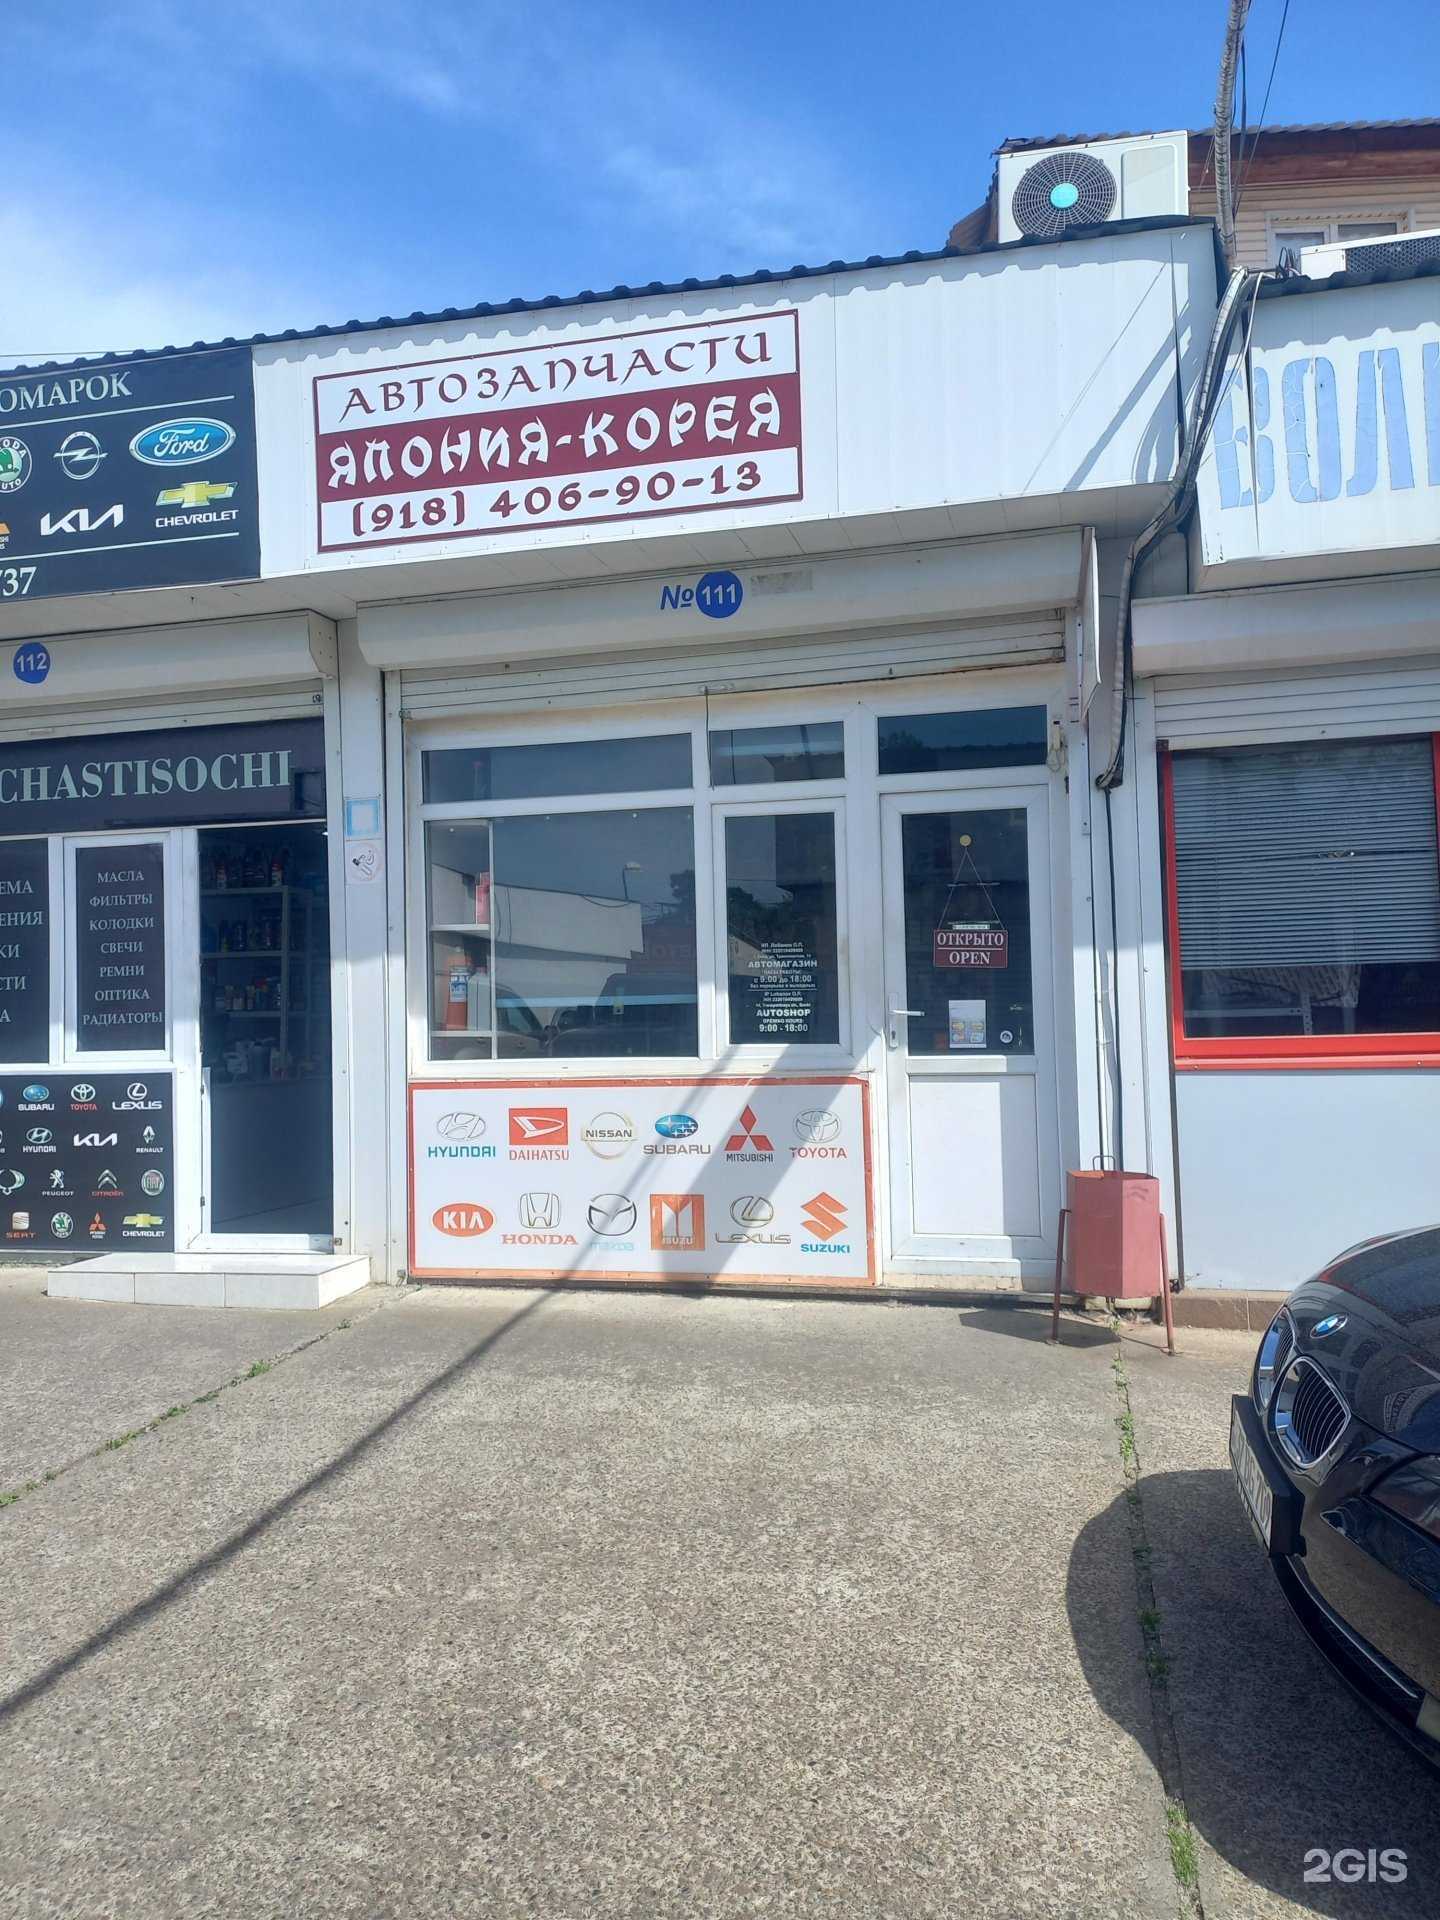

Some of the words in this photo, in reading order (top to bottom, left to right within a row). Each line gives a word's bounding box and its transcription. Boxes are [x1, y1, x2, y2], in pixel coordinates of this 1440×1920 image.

[340, 331, 772, 422] АВТОЗАПЧАСТИ
[153, 428, 209, 457] Ford
[328, 386, 782, 488] ЯПОНИЯ-КОРЕЯ
[489, 461, 761, 519] 406-90-13
[41, 504, 124, 536] KIA
[155, 509, 239, 528] CHEVROLET
[0, 566, 37, 596] 37
[17, 652, 47, 672] 112
[0, 750, 292, 803] CHASTISOCHI
[97, 870, 144, 883] МАСЛА
[89, 894, 153, 907] ФИЛЬТРЫ
[89, 917, 154, 931] КОЛОДКИ
[937, 932, 1004, 946] ОТКРЫТО
[100, 941, 143, 954] СВЕЧИ
[748, 960, 818, 968] АВТОМАГАЗИН
[950, 951, 990, 964] OPEN
[100, 965, 144, 977] РЕМНИ
[94, 988, 150, 1001] ОПТИКА
[83, 1012, 162, 1026] РАДИАТОРЫ
[756, 1009, 811, 1017] AUTOSHOP
[759, 1024, 778, 1032] 9:00
[785, 1024, 808, 1032] 18:00
[18, 1103, 55, 1111] SUBARU
[70, 1103, 97, 1111] TOYOTA
[112, 1101, 162, 1110] LEXUS
[73, 1133, 118, 1147] KIA
[585, 1129, 632, 1138] NISSAN
[23, 1145, 56, 1153] HYUNDAI
[428, 1146, 496, 1158] HYUNDAI
[509, 1150, 569, 1161] DAIHATSU
[643, 1144, 711, 1155] SUBARU
[789, 1147, 847, 1159] TOYOTA
[726, 1153, 774, 1163] MITSUBISHI
[443, 1211, 485, 1229] KIA
[122, 1230, 165, 1238] CHEVROLET
[502, 1234, 578, 1245] HONDA
[715, 1233, 792, 1245] LEXUS
[800, 1243, 850, 1253] SUZUKI
